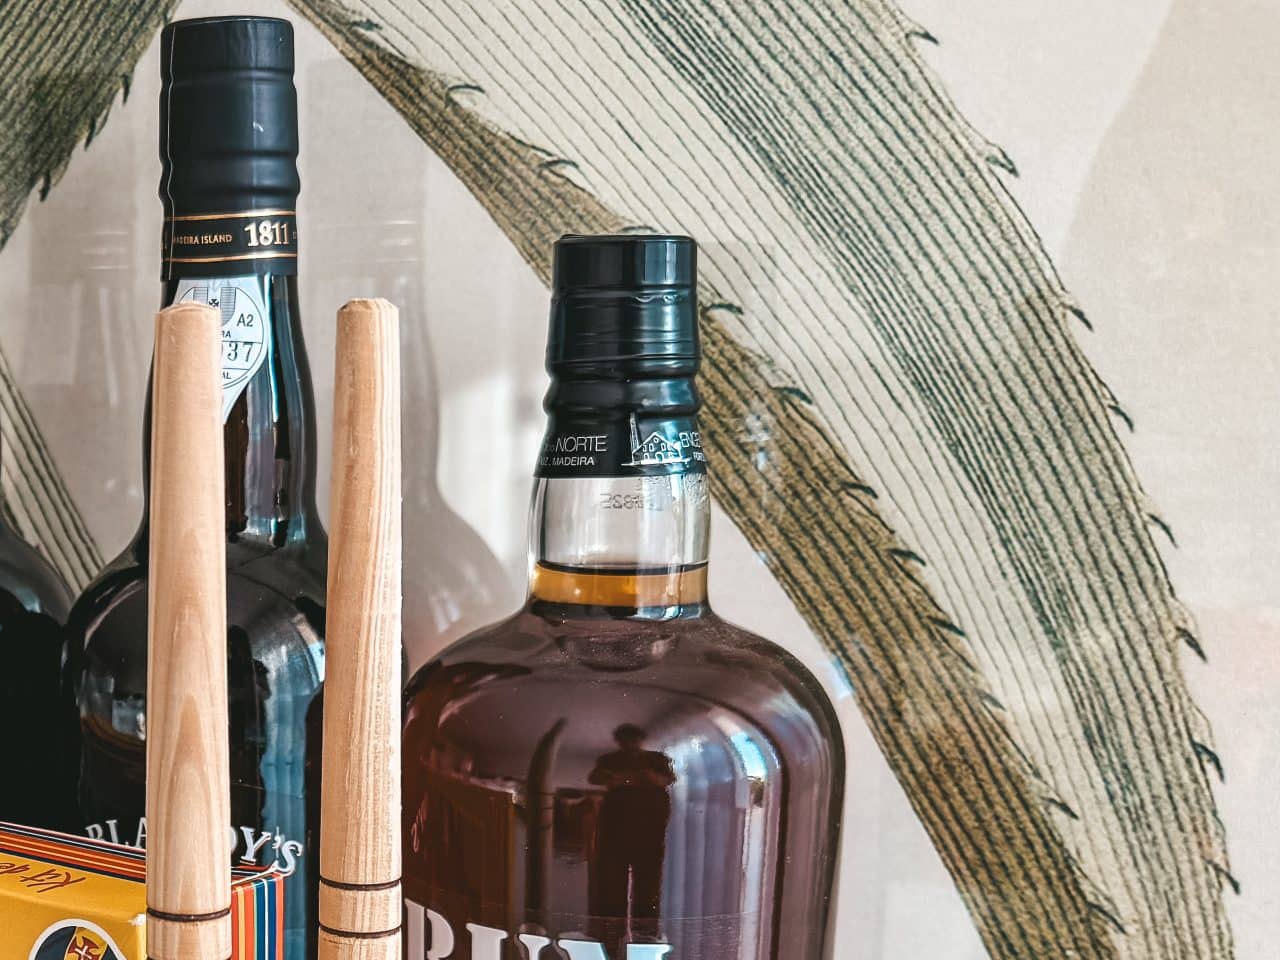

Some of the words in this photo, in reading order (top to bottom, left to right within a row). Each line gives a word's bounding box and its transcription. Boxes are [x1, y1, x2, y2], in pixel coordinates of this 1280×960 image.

[201, 233, 233, 245] ISLAND
[244, 219, 289, 247] 1811
[237, 312, 254, 327] A2
[555, 435, 608, 452] NORTE
[552, 456, 595, 466] MADEIRA
[20, 868, 86, 893] Kit
